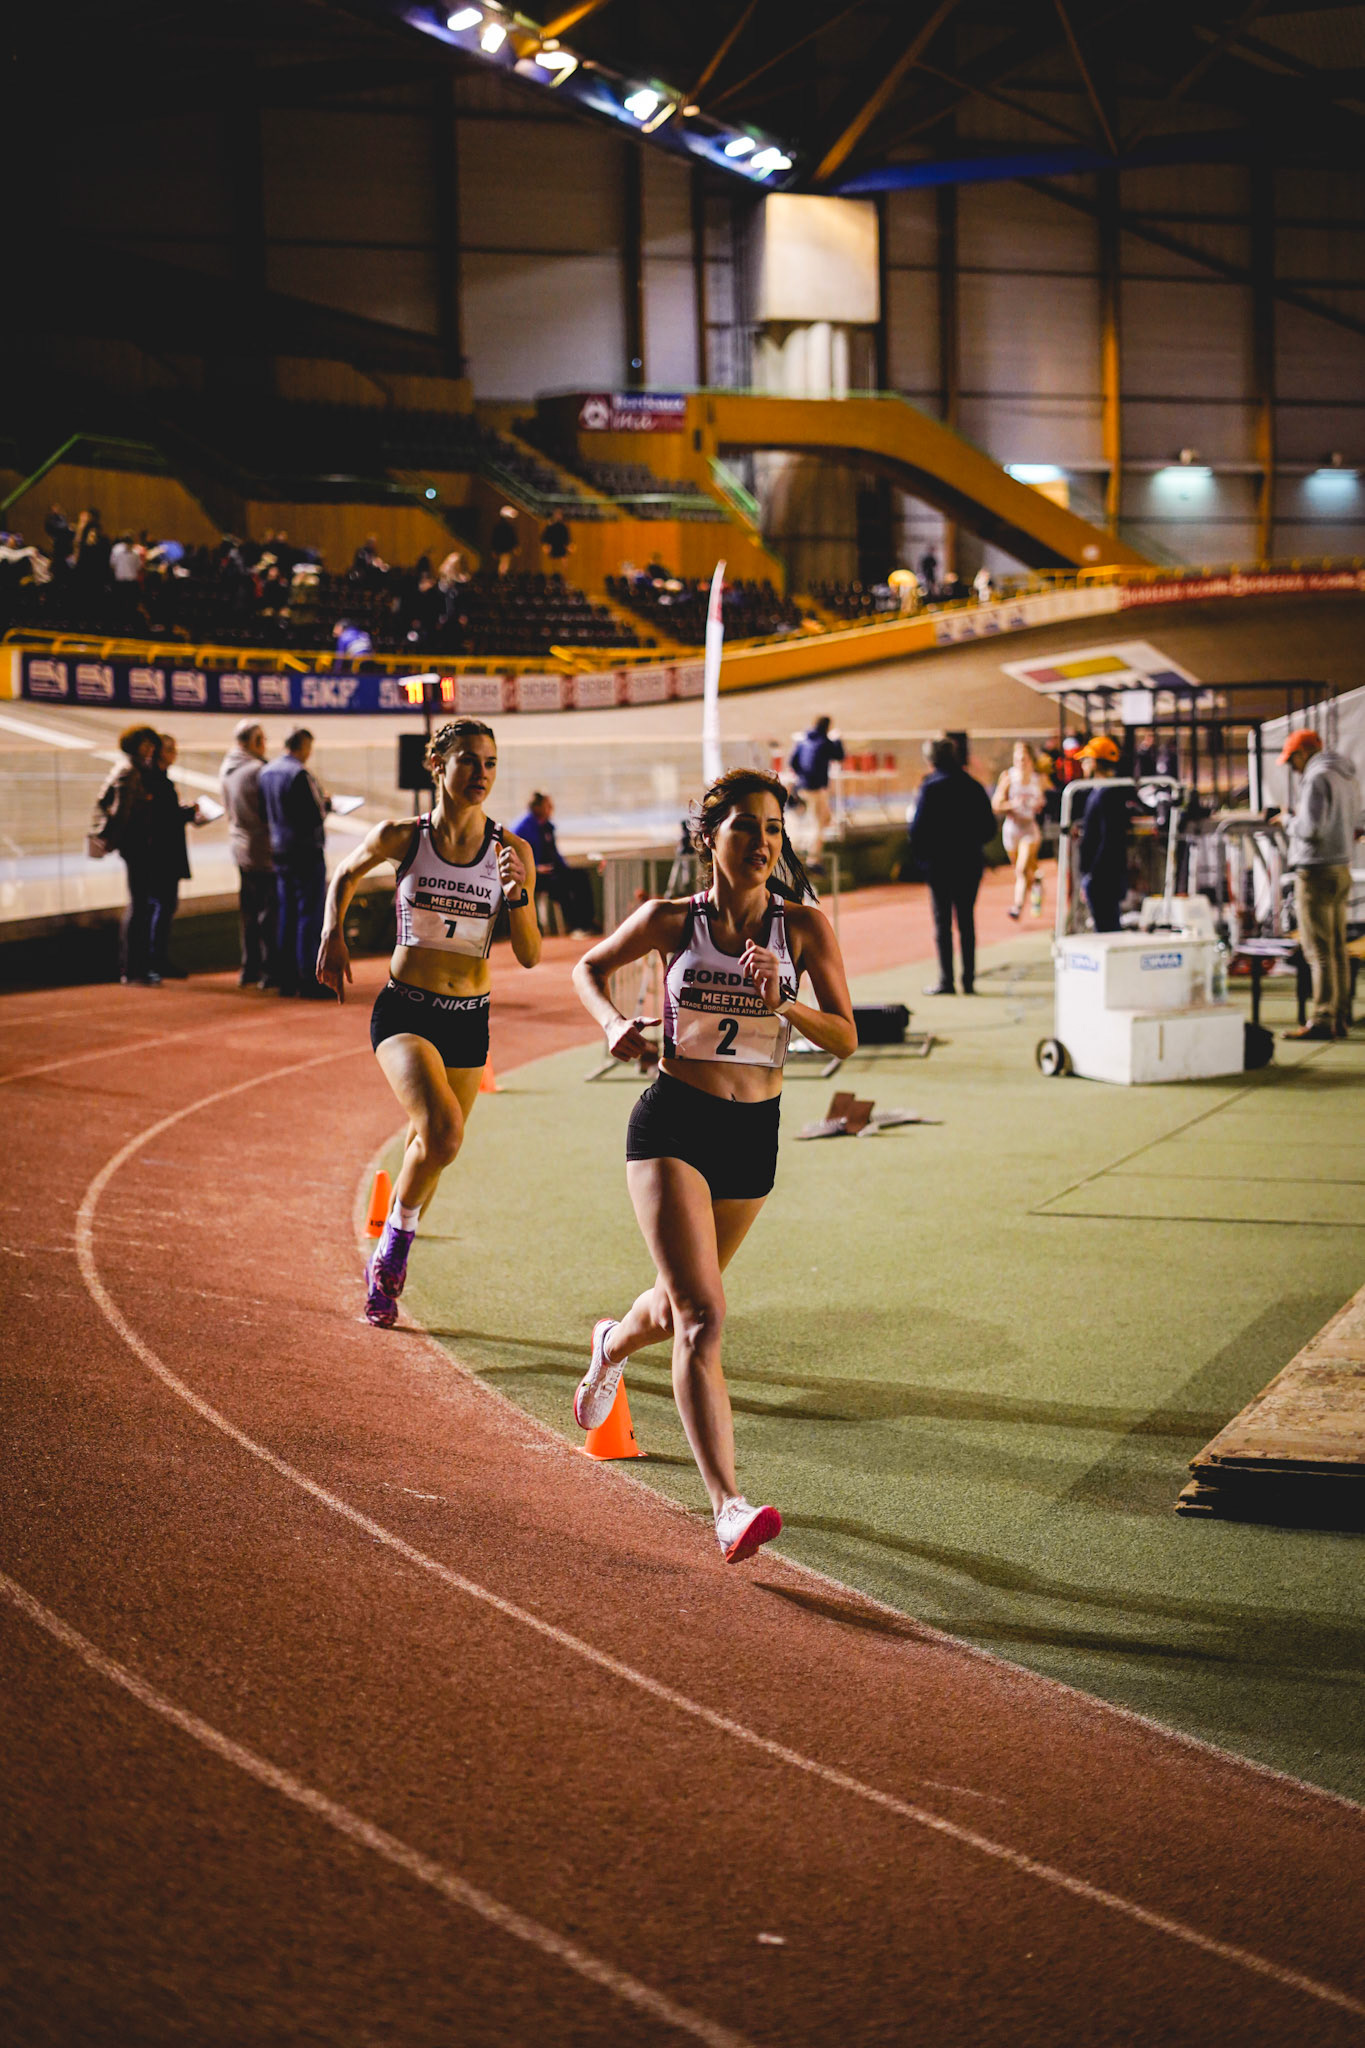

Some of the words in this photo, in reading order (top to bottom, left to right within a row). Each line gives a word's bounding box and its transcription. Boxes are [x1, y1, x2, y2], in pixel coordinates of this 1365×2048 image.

[418, 876, 493, 900] BORDEAUX
[431, 896, 478, 911] MEETING
[444, 919, 458, 939] 7
[387, 979, 424, 1002] PRO
[432, 997, 479, 1011] NIKE
[701, 992, 764, 1009] MEETING
[681, 1000, 701, 1010] STADE
[702, 1004, 740, 1014] BORDELAIS
[715, 1018, 739, 1055] 2
